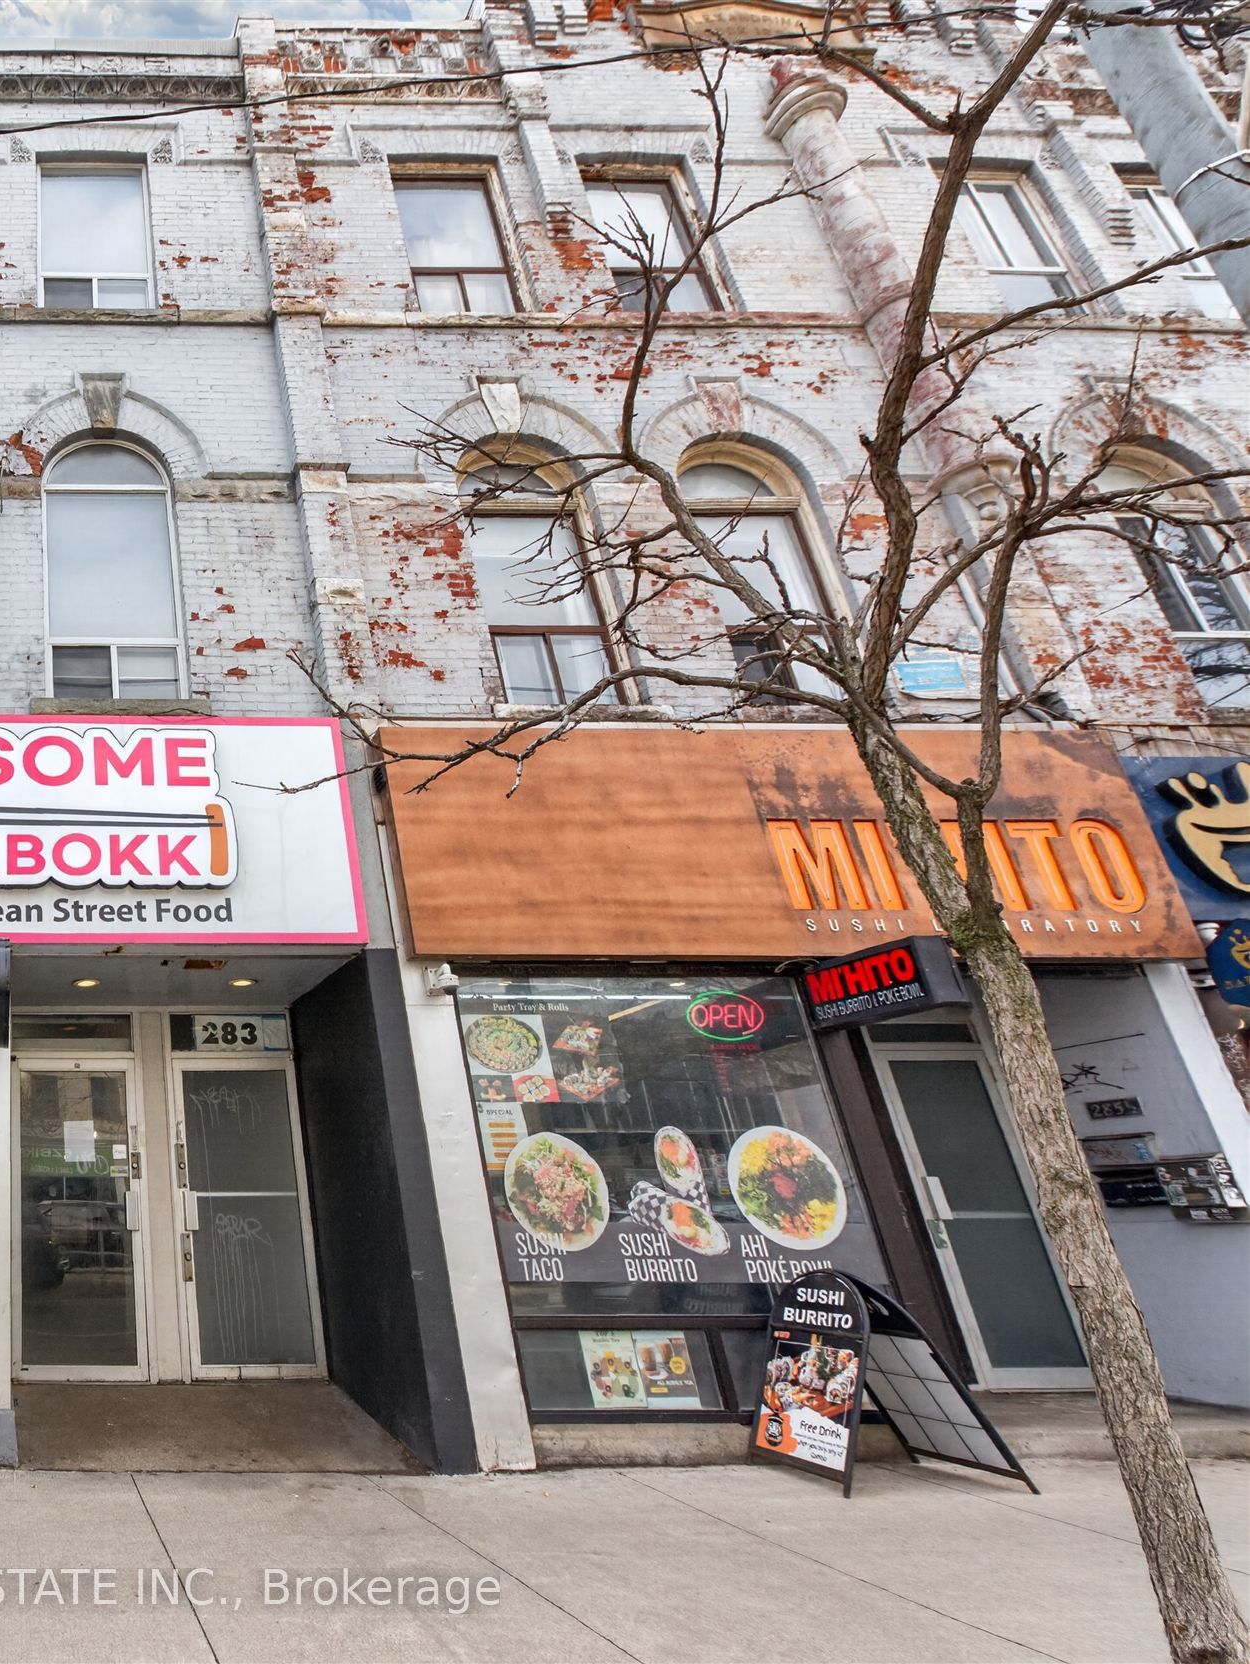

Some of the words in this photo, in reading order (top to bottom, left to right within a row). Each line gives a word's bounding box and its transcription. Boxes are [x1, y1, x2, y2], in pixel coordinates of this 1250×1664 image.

[53, 898, 146, 923] Street
[156, 898, 233, 923] Food
[806, 917, 905, 933] SUSHI
[932, 917, 1143, 934] LRATORY
[492, 1003, 516, 1012] Party
[517, 1002, 536, 1012] Tray
[538, 1003, 546, 1011] &
[548, 1002, 569, 1011] Rolls
[691, 1004, 755, 1029] OPEN
[815, 1001, 839, 1020] SUSHI
[837, 996, 872, 1015] BURRITO
[201, 1022, 258, 1045] 283
[515, 1232, 567, 1256] SUSHI
[618, 1232, 671, 1257] SUSHI
[740, 1234, 769, 1258] AHI
[519, 1258, 564, 1282] TACO
[624, 1258, 698, 1283] BURRITO
[796, 1287, 846, 1306] SUSHI
[783, 1307, 853, 1329] BURRITO
[800, 1420, 818, 1434] Free
[819, 1426, 842, 1440] Drink
